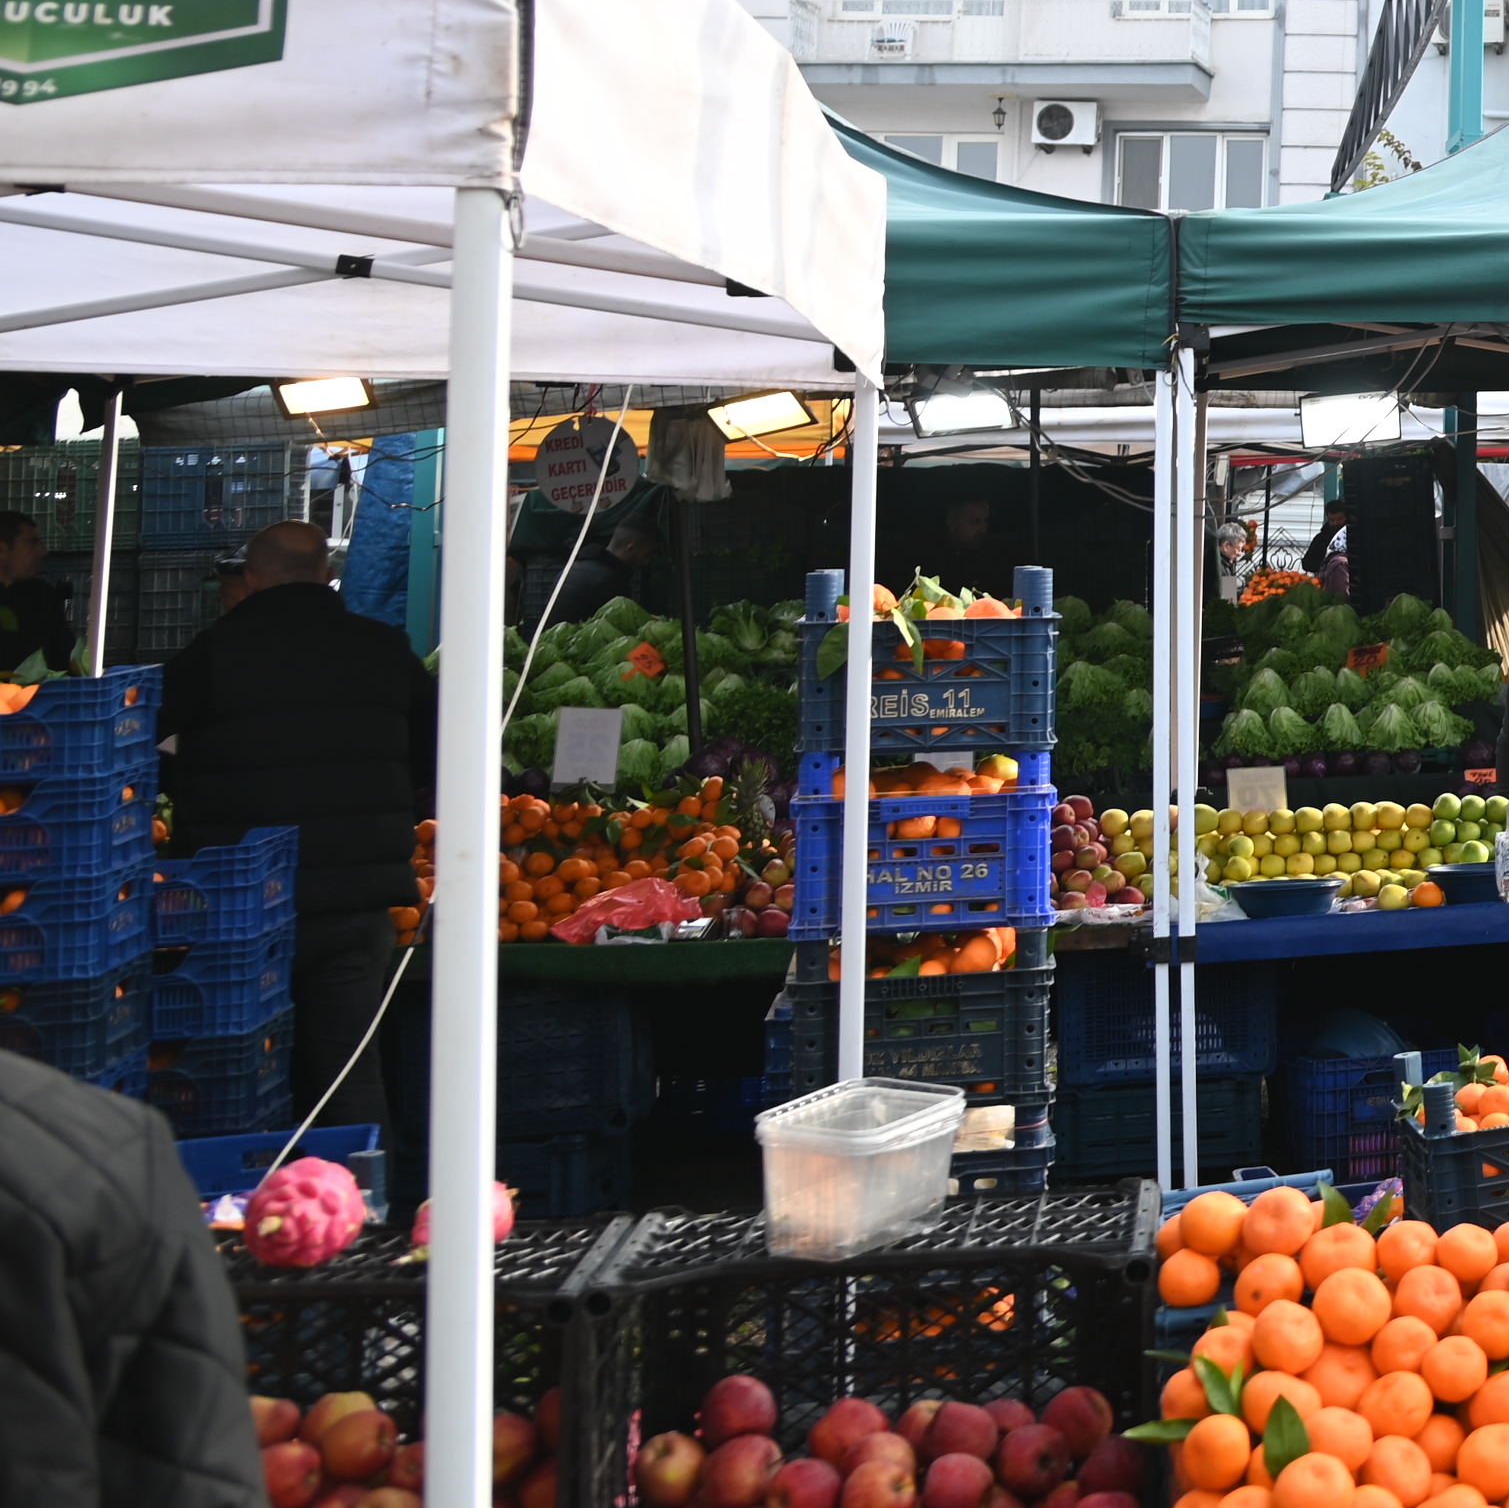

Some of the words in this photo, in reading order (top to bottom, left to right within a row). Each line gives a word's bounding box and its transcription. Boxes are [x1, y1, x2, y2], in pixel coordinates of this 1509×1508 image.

[3, 1, 175, 26] UCULUK
[0, 79, 56, 96] 994
[545, 433, 584, 453] KREDİ
[548, 459, 587, 477] KARTI
[942, 688, 971, 708] 11
[929, 706, 985, 719] EMİRALEM
[917, 865, 952, 880] NO
[960, 862, 989, 879] 26
[895, 879, 953, 894] İZMİR
